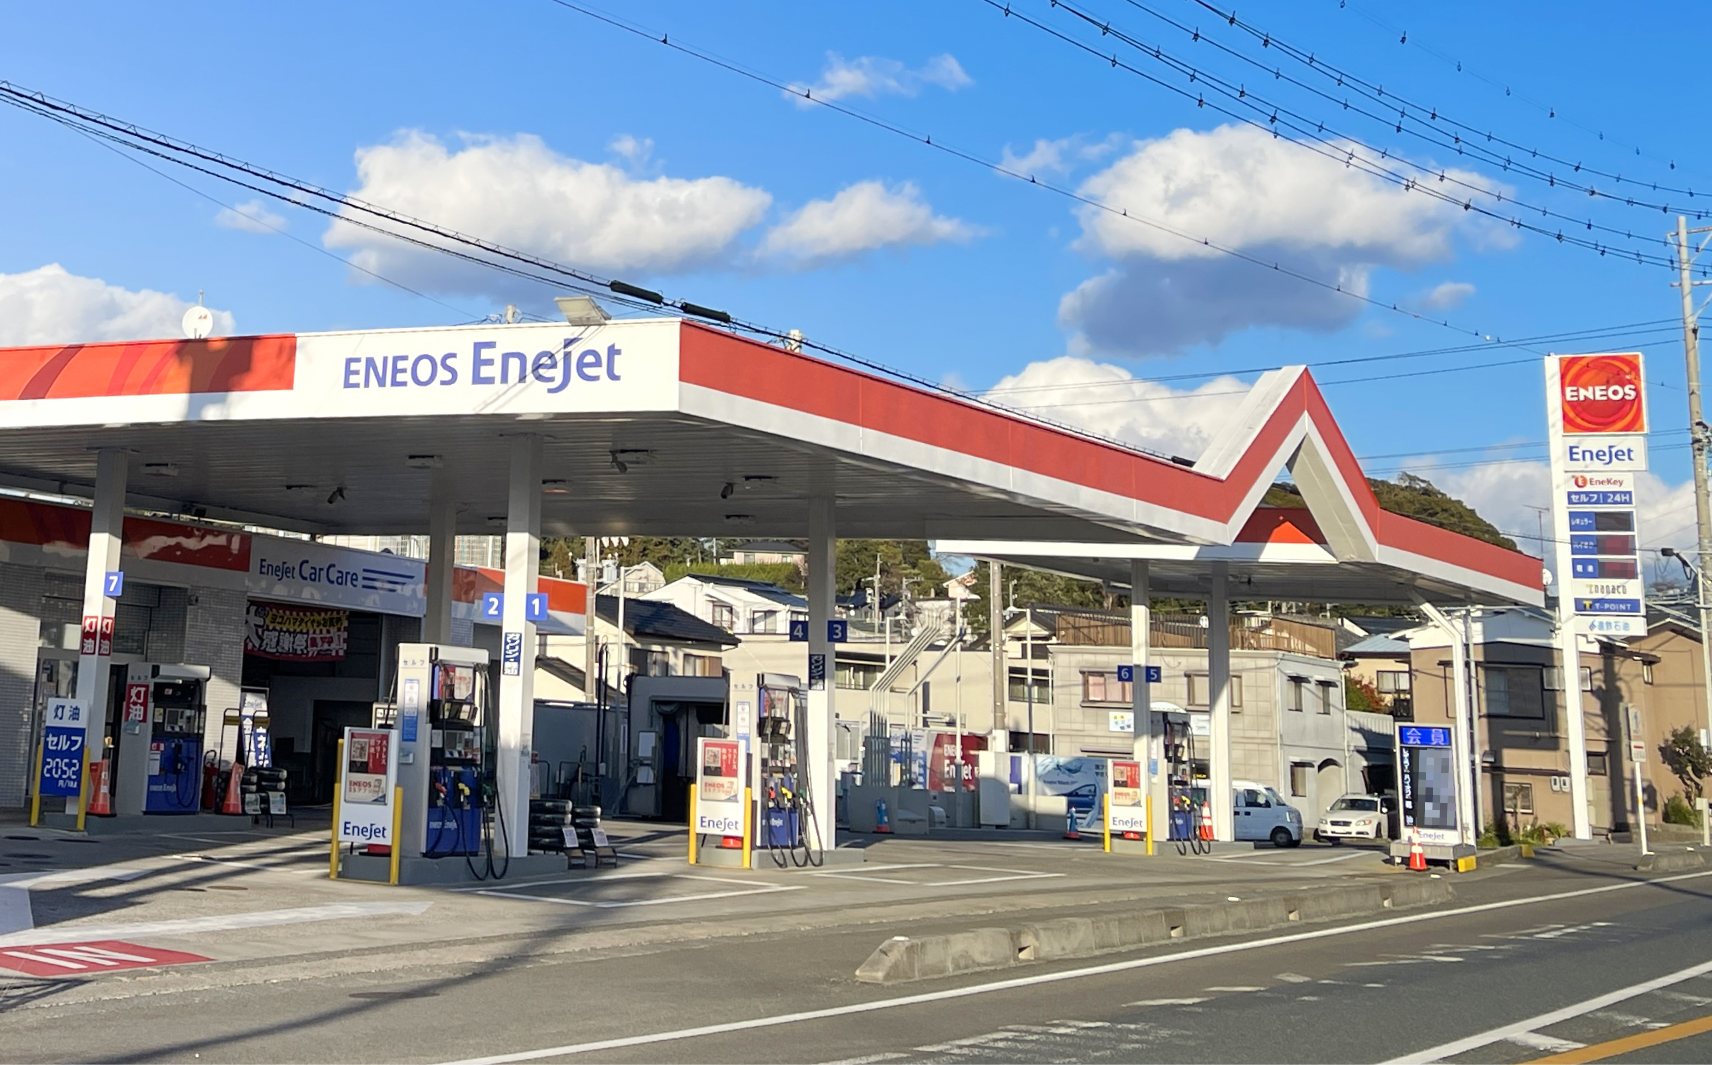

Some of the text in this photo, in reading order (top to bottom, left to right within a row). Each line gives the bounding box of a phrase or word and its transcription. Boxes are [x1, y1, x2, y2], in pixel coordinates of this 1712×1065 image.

[344, 337, 622, 394] ENEOS Enejet
[1565, 385, 1636, 401] ENEOS
[1569, 445, 1634, 465] Enejet
[1589, 478, 1624, 488] EneKey
[1571, 493, 1629, 503] セルフ 24H
[259, 558, 359, 588] Enejet Car Care
[108, 575, 118, 592] 7
[488, 597, 498, 615] 2
[532, 598, 540, 616] 1
[83, 617, 98, 654] 灯油
[99, 617, 114, 654] 灯油
[793, 624, 803, 638] 4
[833, 624, 842, 639] 3
[1121, 668, 1129, 679] 6
[1150, 668, 1158, 680] 5
[128, 686, 146, 721] 灯油
[54, 704, 80, 721] 灯油
[46, 733, 82, 751] セルフ
[1406, 728, 1445, 745] 会員
[944, 744, 963, 756] ENES
[44, 758, 79, 779] 2052
[343, 821, 387, 840] Enejet
